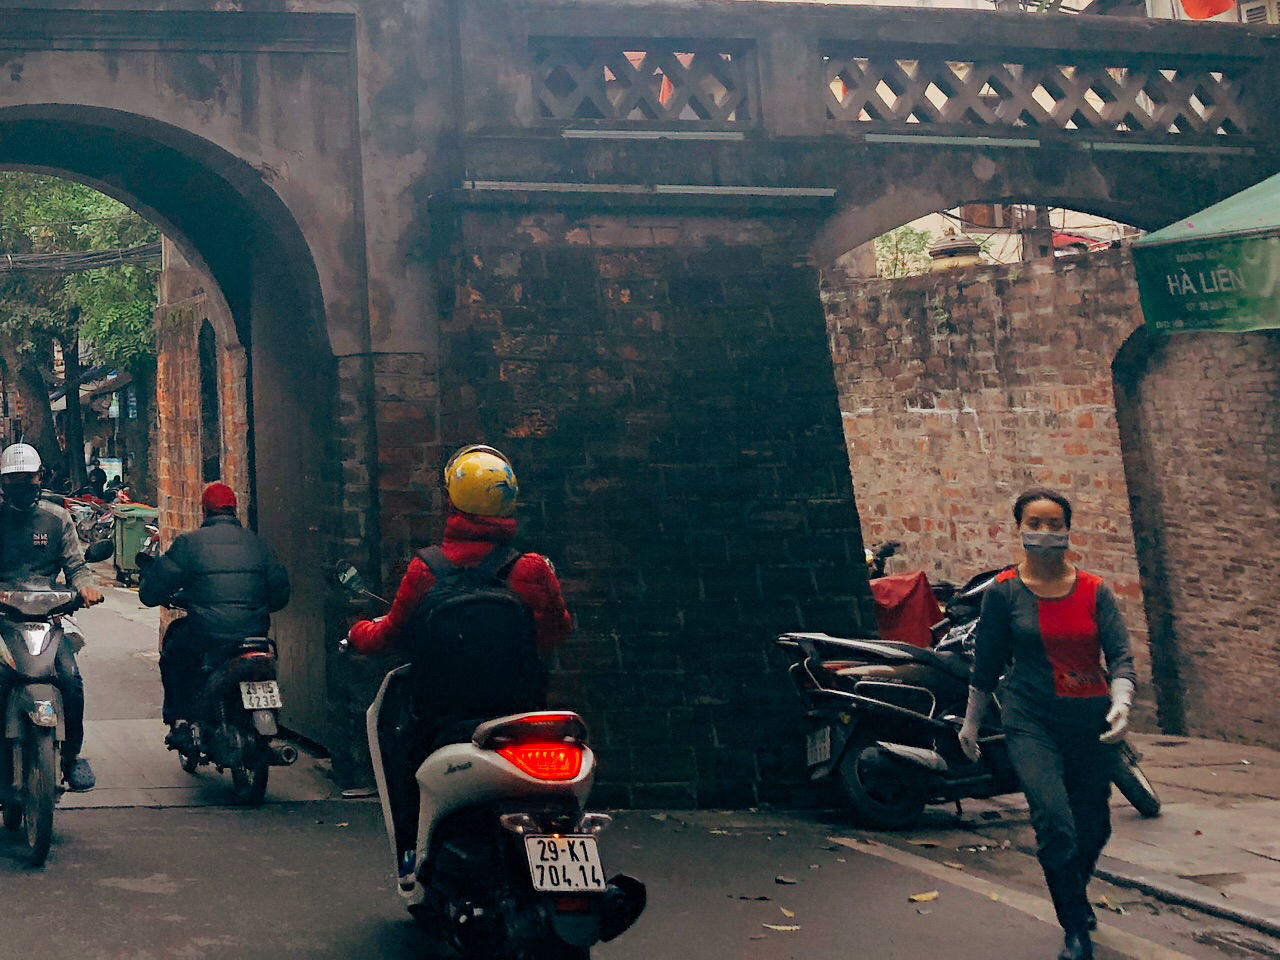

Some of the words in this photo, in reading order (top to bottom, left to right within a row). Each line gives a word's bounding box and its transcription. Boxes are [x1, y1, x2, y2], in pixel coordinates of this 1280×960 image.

[1166, 267, 1198, 296] HÀ
[1199, 263, 1248, 294] LIÊN
[536, 839, 589, 862] 29-K1
[535, 864, 601, 887] 704.14
